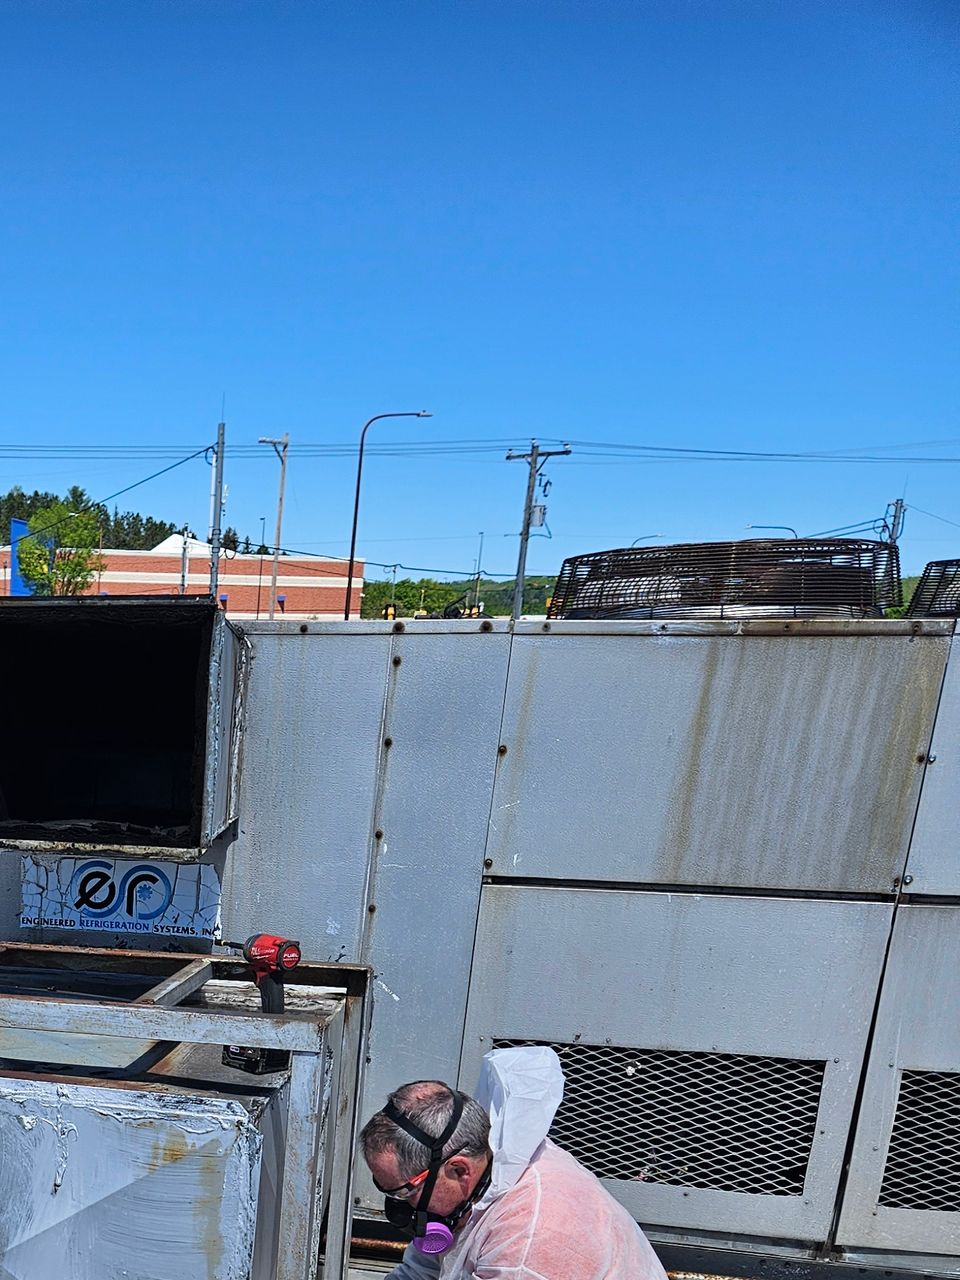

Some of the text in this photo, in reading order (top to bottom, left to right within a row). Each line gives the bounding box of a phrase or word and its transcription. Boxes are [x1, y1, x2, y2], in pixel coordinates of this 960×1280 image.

[21, 916, 76, 927] ENGINEERED
[80, 919, 150, 931] REFRIGERATION
[153, 924, 199, 936] SYSTEMS,
